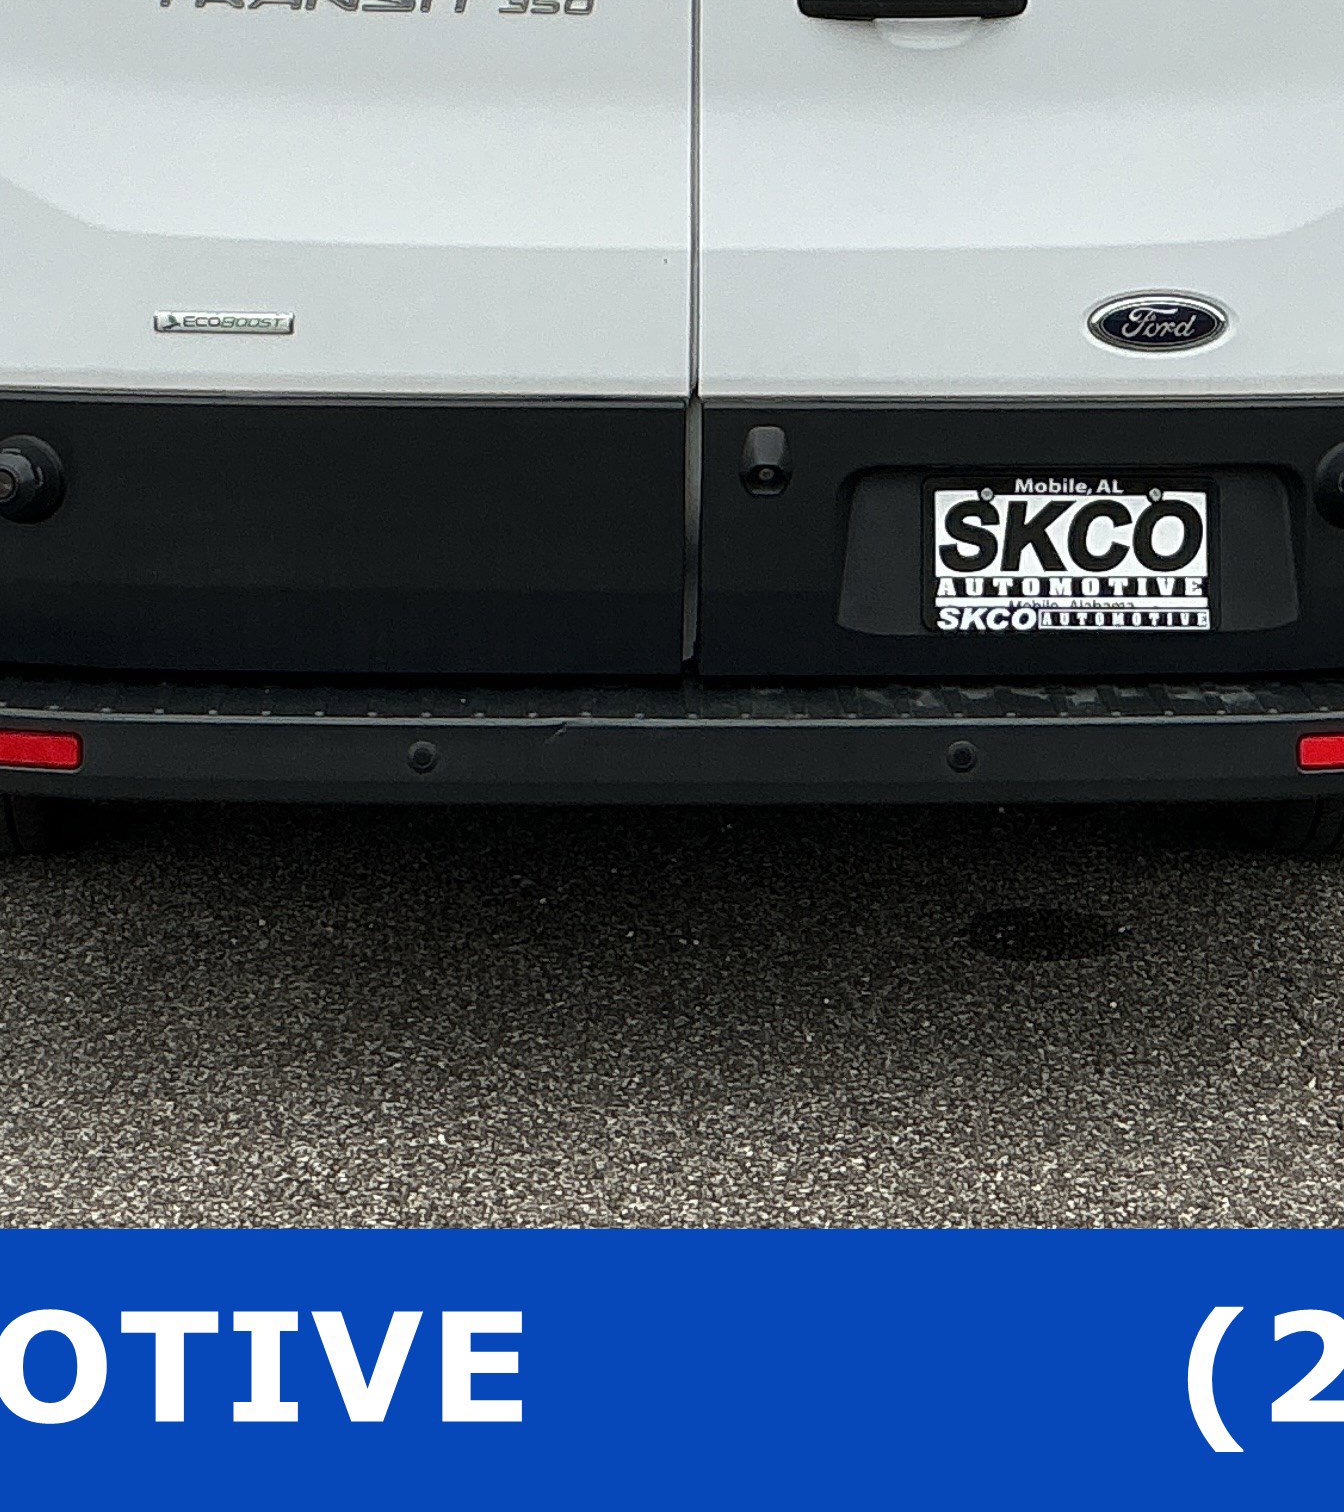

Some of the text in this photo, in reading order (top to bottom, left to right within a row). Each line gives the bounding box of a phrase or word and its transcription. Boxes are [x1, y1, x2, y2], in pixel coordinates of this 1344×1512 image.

[1121, 306, 1197, 338] Ford
[1014, 477, 1125, 496] Mobile, AL
[938, 499, 1204, 573] SKCO
[936, 577, 1204, 597] AUTOMOTIVE
[937, 608, 1208, 631] SKCO AUTOMOTIVE
